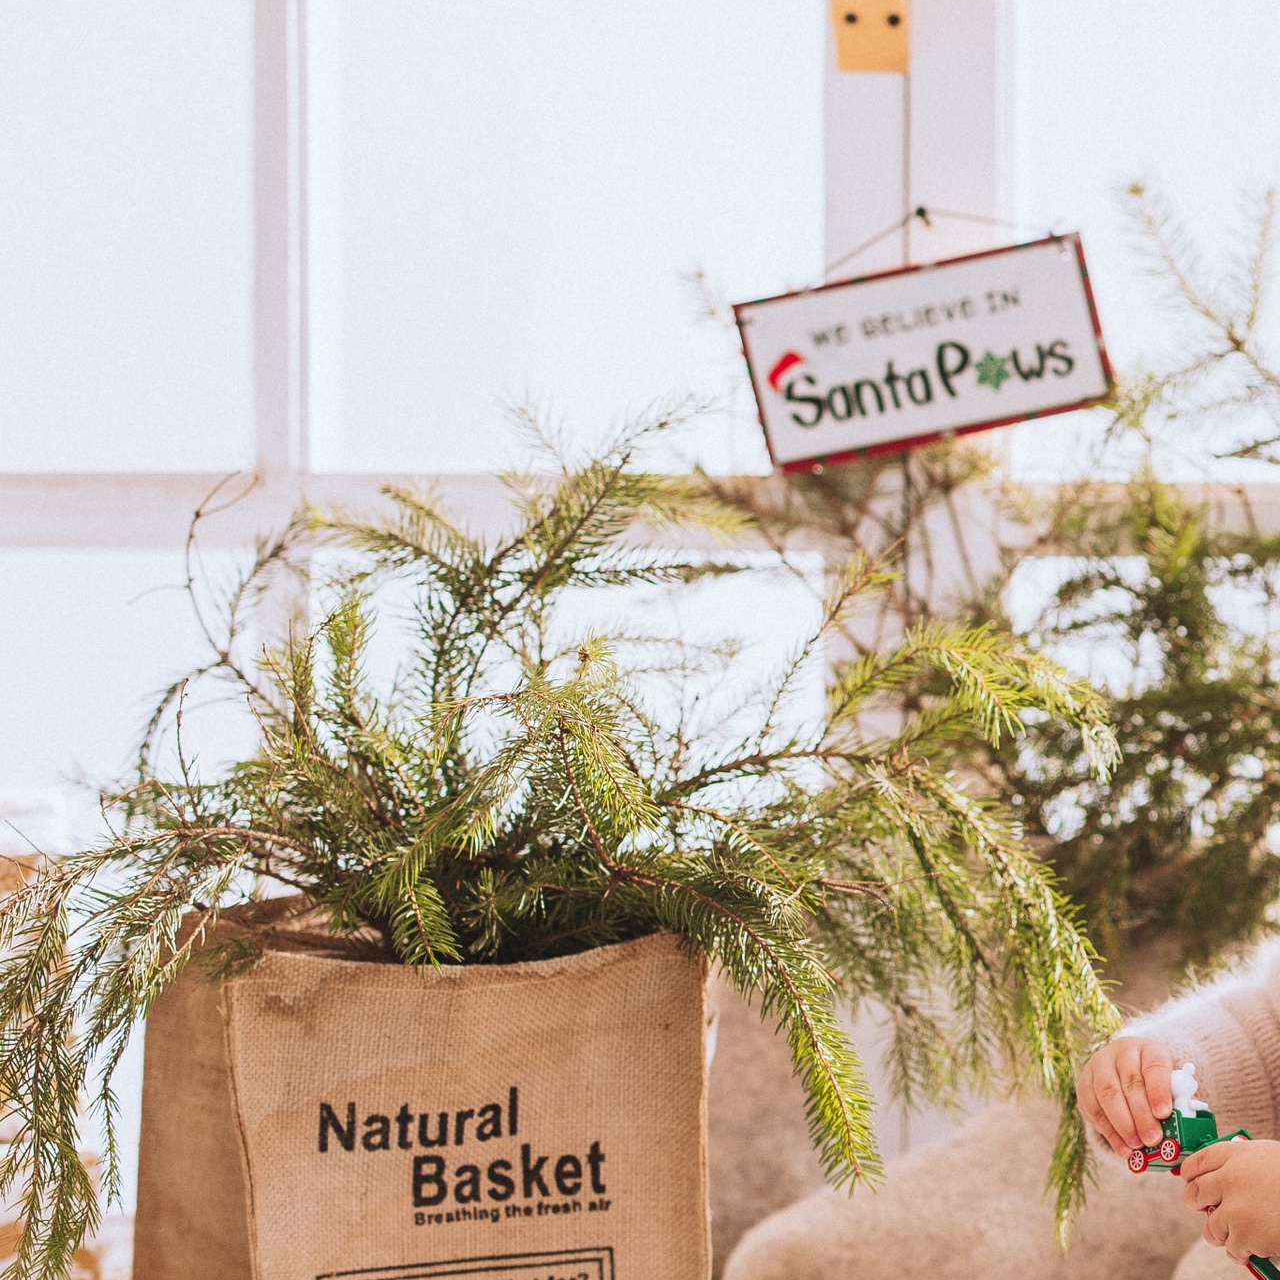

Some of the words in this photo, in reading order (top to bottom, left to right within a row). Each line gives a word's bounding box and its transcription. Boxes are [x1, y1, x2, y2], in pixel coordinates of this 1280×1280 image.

[810, 324, 849, 348] WE
[861, 298, 974, 339] BELIEVE
[985, 288, 1022, 314] IN
[317, 1085, 519, 1153] Natural
[412, 1140, 607, 1208] Basket
[413, 1205, 500, 1226] Breathing
[504, 1202, 534, 1219] the
[536, 1199, 583, 1216] fresh
[588, 1198, 613, 1213] air
